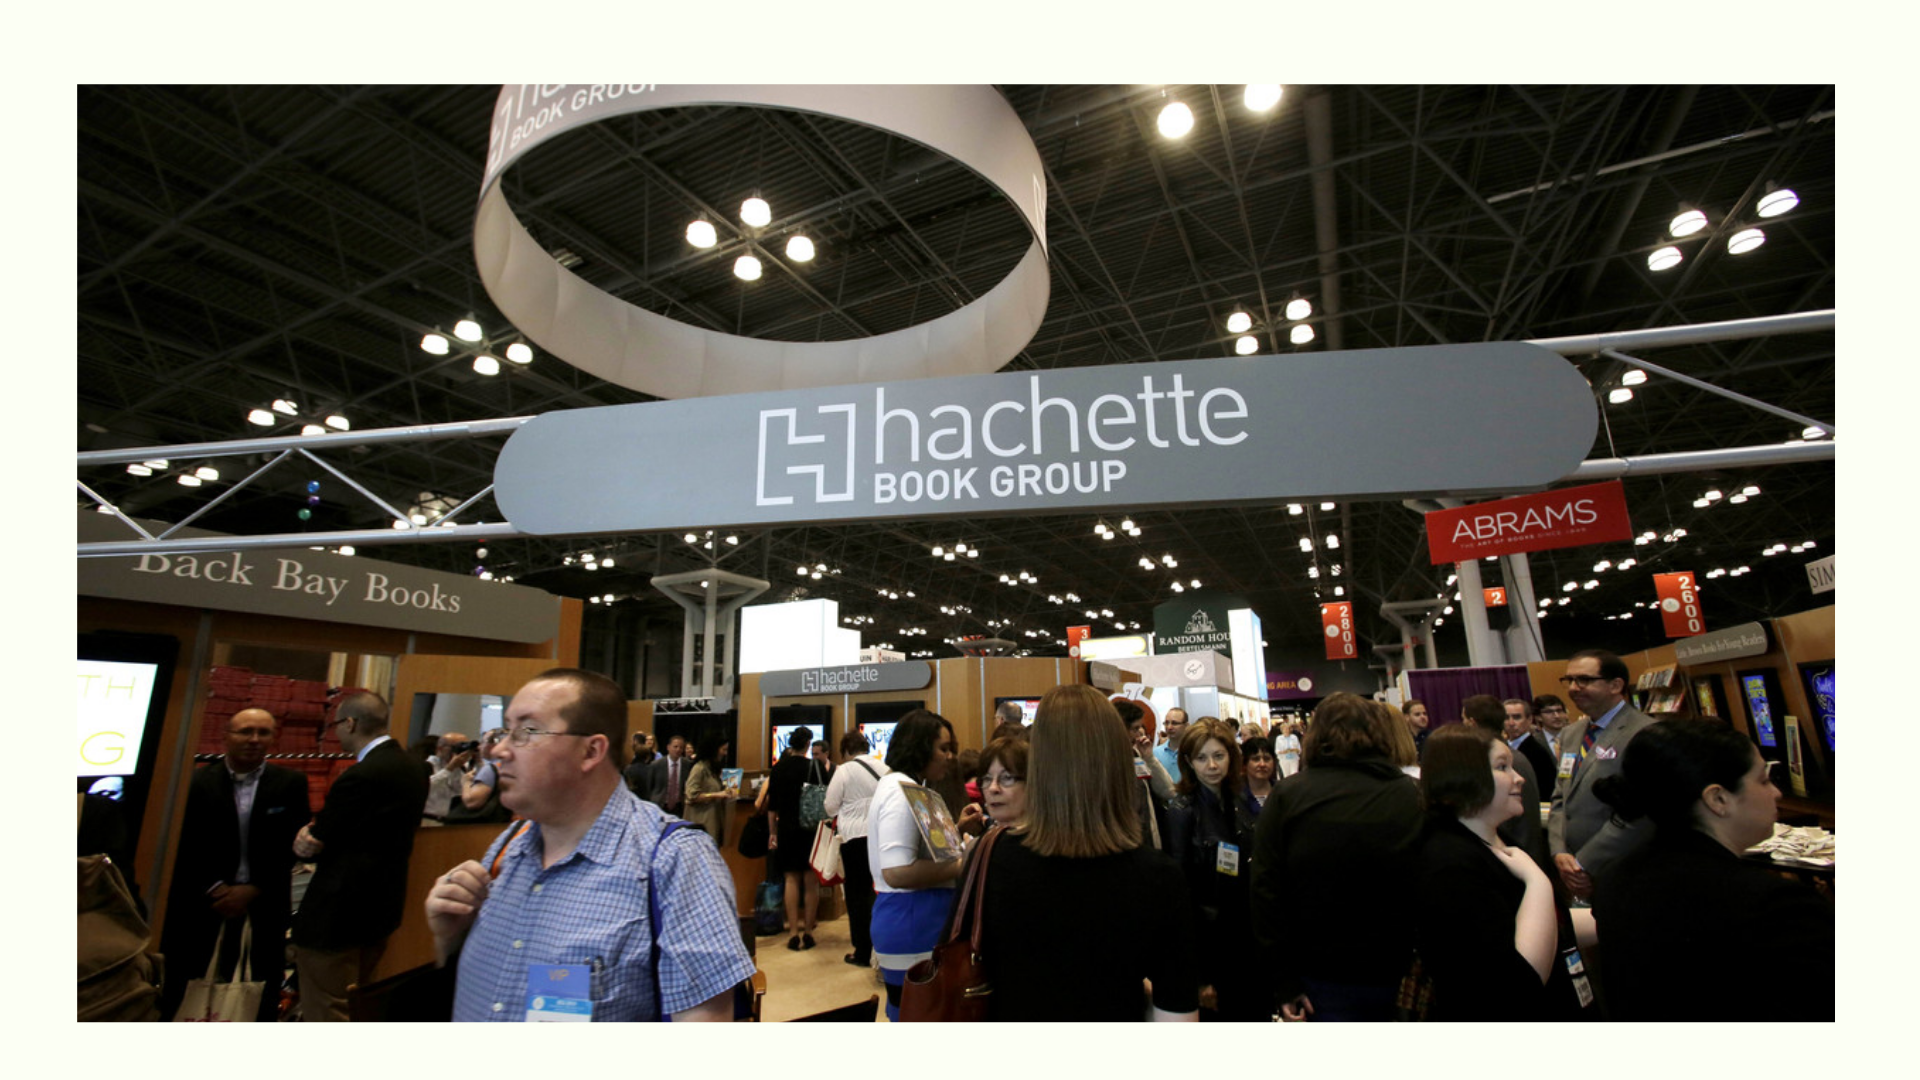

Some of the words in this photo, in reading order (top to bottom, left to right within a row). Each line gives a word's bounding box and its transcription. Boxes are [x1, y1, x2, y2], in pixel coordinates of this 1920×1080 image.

[509, 98, 567, 150] BOOK
[875, 374, 1249, 464] hachette
[875, 467, 980, 504] BOOK
[989, 460, 1127, 498] GROUP
[1452, 499, 1598, 544] ABRAMS
[132, 551, 254, 586] Back
[272, 558, 349, 605] Bay
[363, 572, 461, 614] Books
[1491, 591, 1504, 605] 2
[1678, 576, 1700, 632] 2600
[1159, 634, 1205, 646] RANDOM
[1339, 605, 1353, 656] 2800
[820, 666, 879, 684] hachette
[820, 684, 837, 692] BOOK
[838, 683, 860, 691] GROUP
